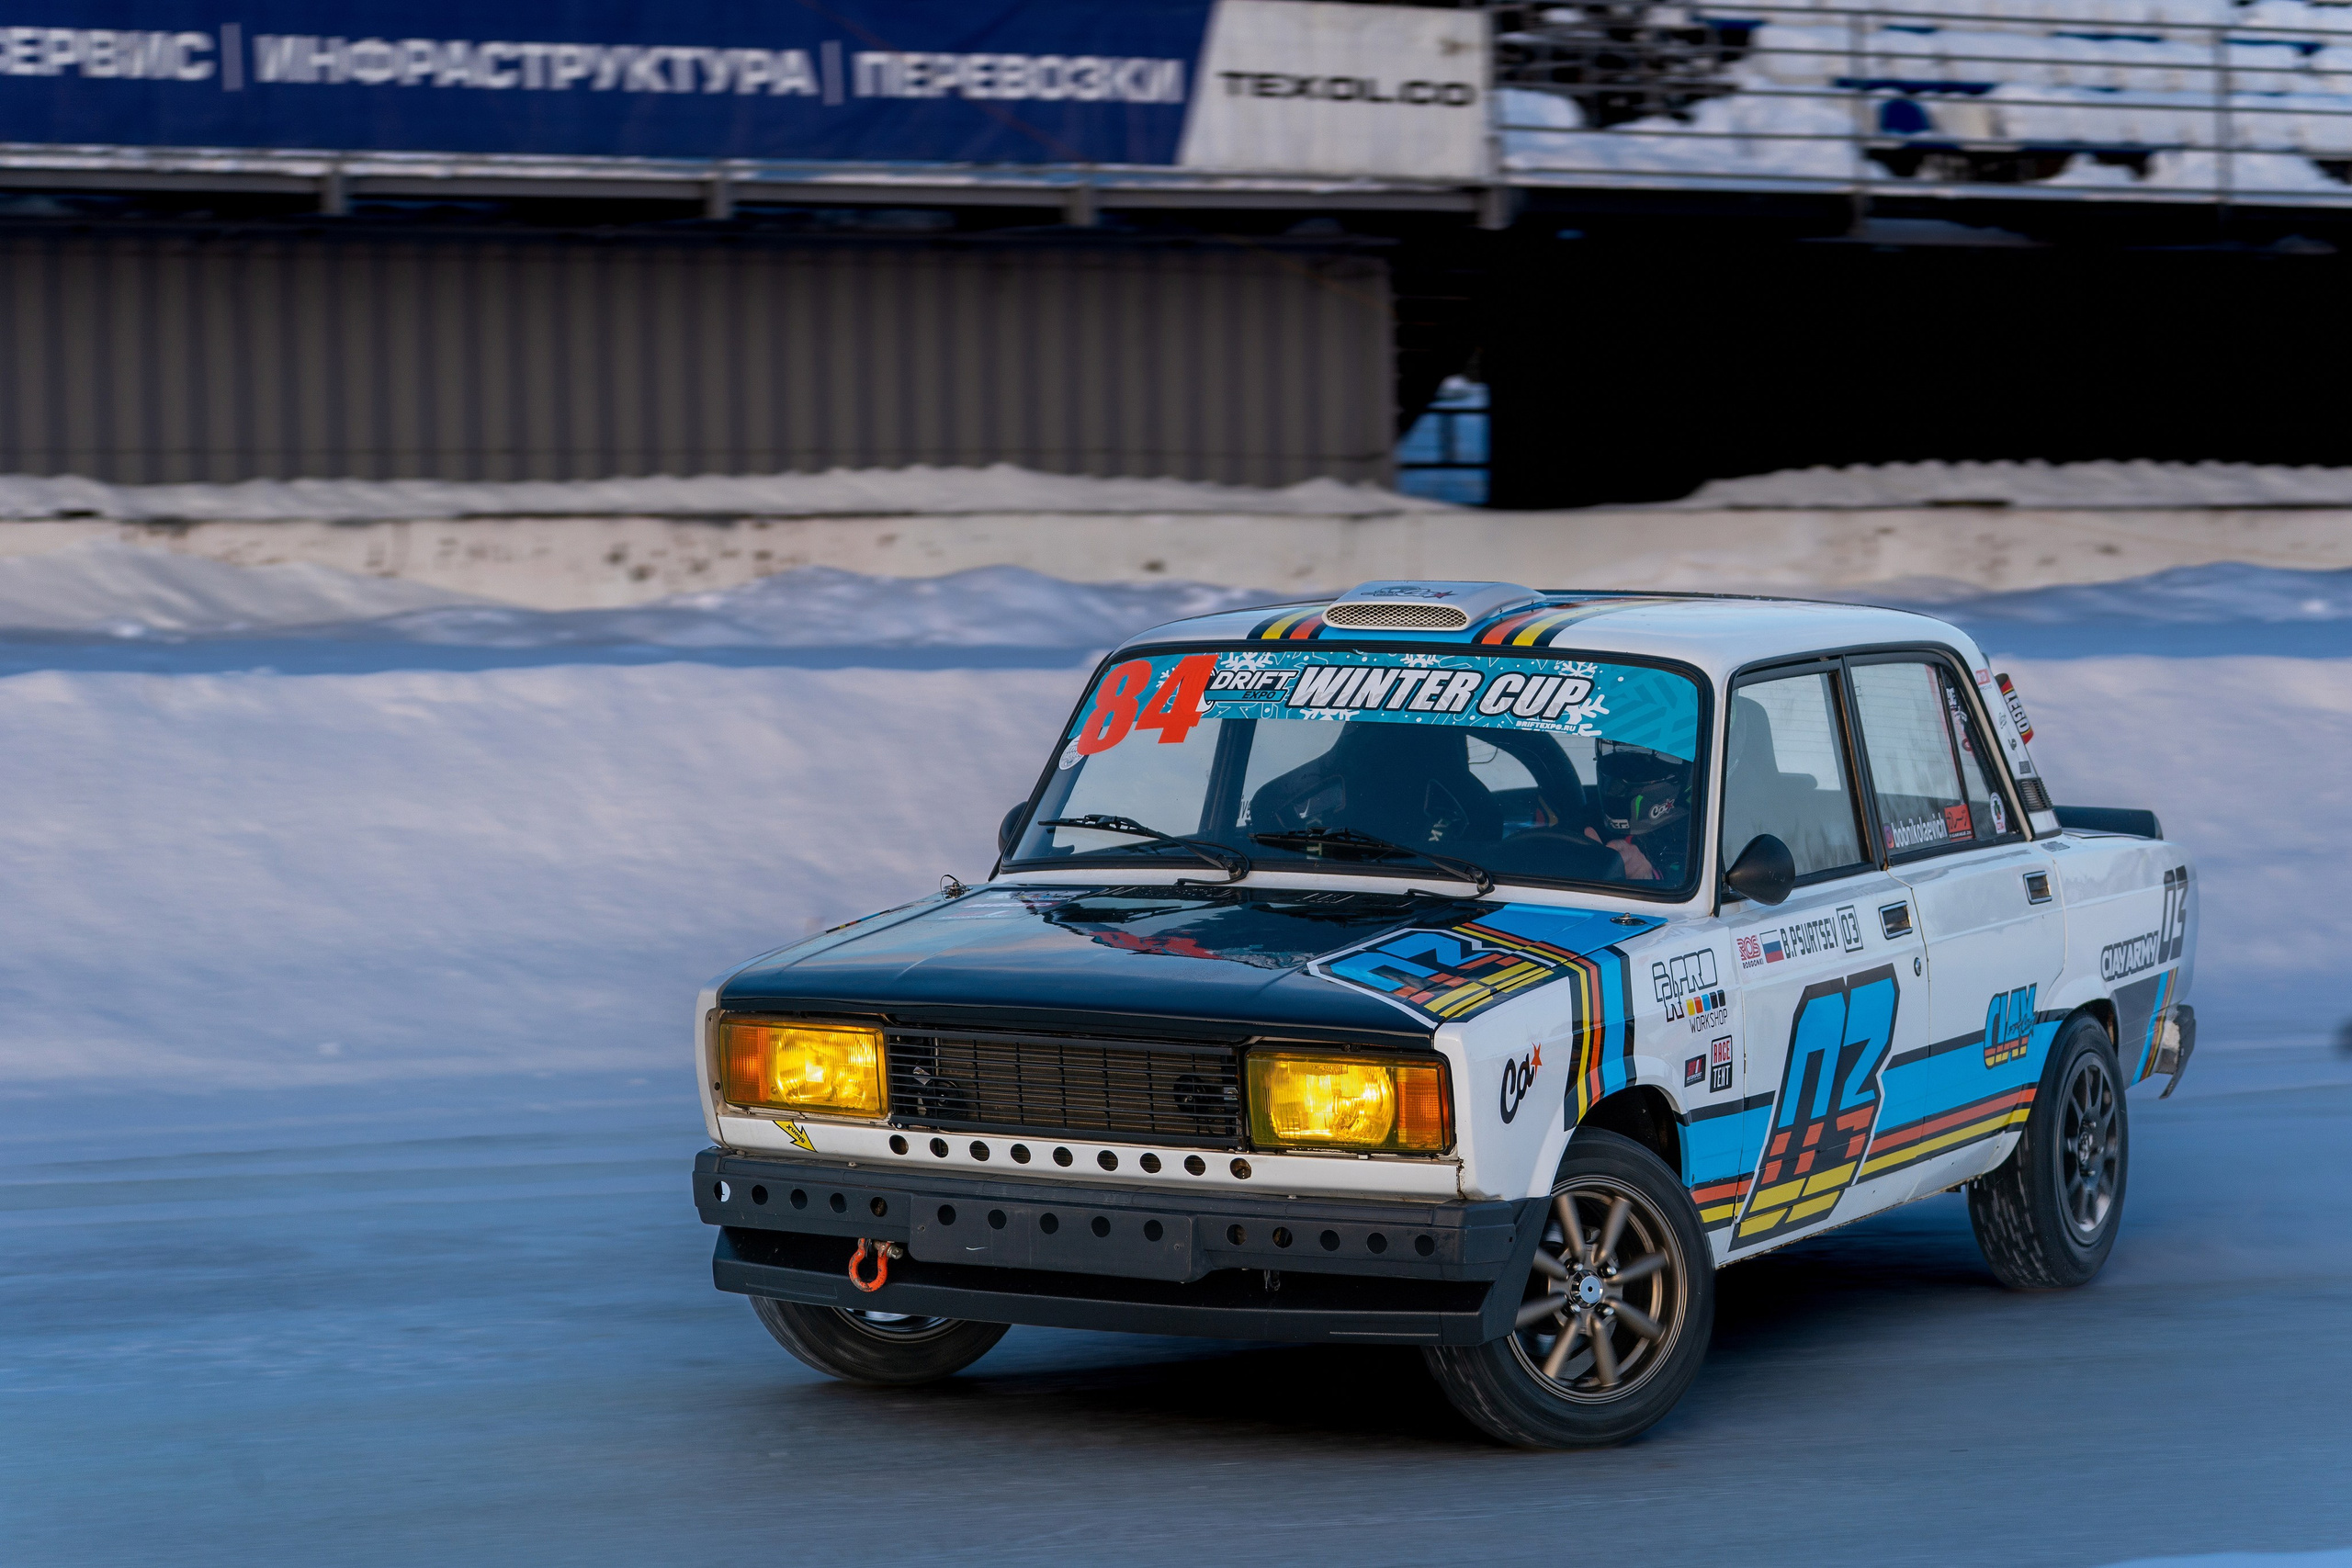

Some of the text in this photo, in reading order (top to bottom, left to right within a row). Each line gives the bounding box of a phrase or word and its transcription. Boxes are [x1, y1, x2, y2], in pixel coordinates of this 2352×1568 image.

[0, 26, 1185, 104] ЕРВИС ИНФРАСТРУКТУРА ПЕРЕВОЗКИ
[1209, 671, 1297, 690] DRIFT
[1241, 690, 1277, 700] EXPO
[1286, 666, 1594, 719] WINTER CUP
[1077, 654, 1219, 756] 84
[2002, 690, 2033, 735] LEGO
[1515, 720, 1577, 732] DRIFTEXPO.RU
[1840, 912, 1860, 945] 03
[2158, 865, 2188, 964] 03
[1736, 934, 1761, 961] ROS
[1689, 1009, 1728, 1033] WORKSHOP
[1984, 982, 2037, 1070] CLAY
[1713, 1040, 1730, 1064] RACE
